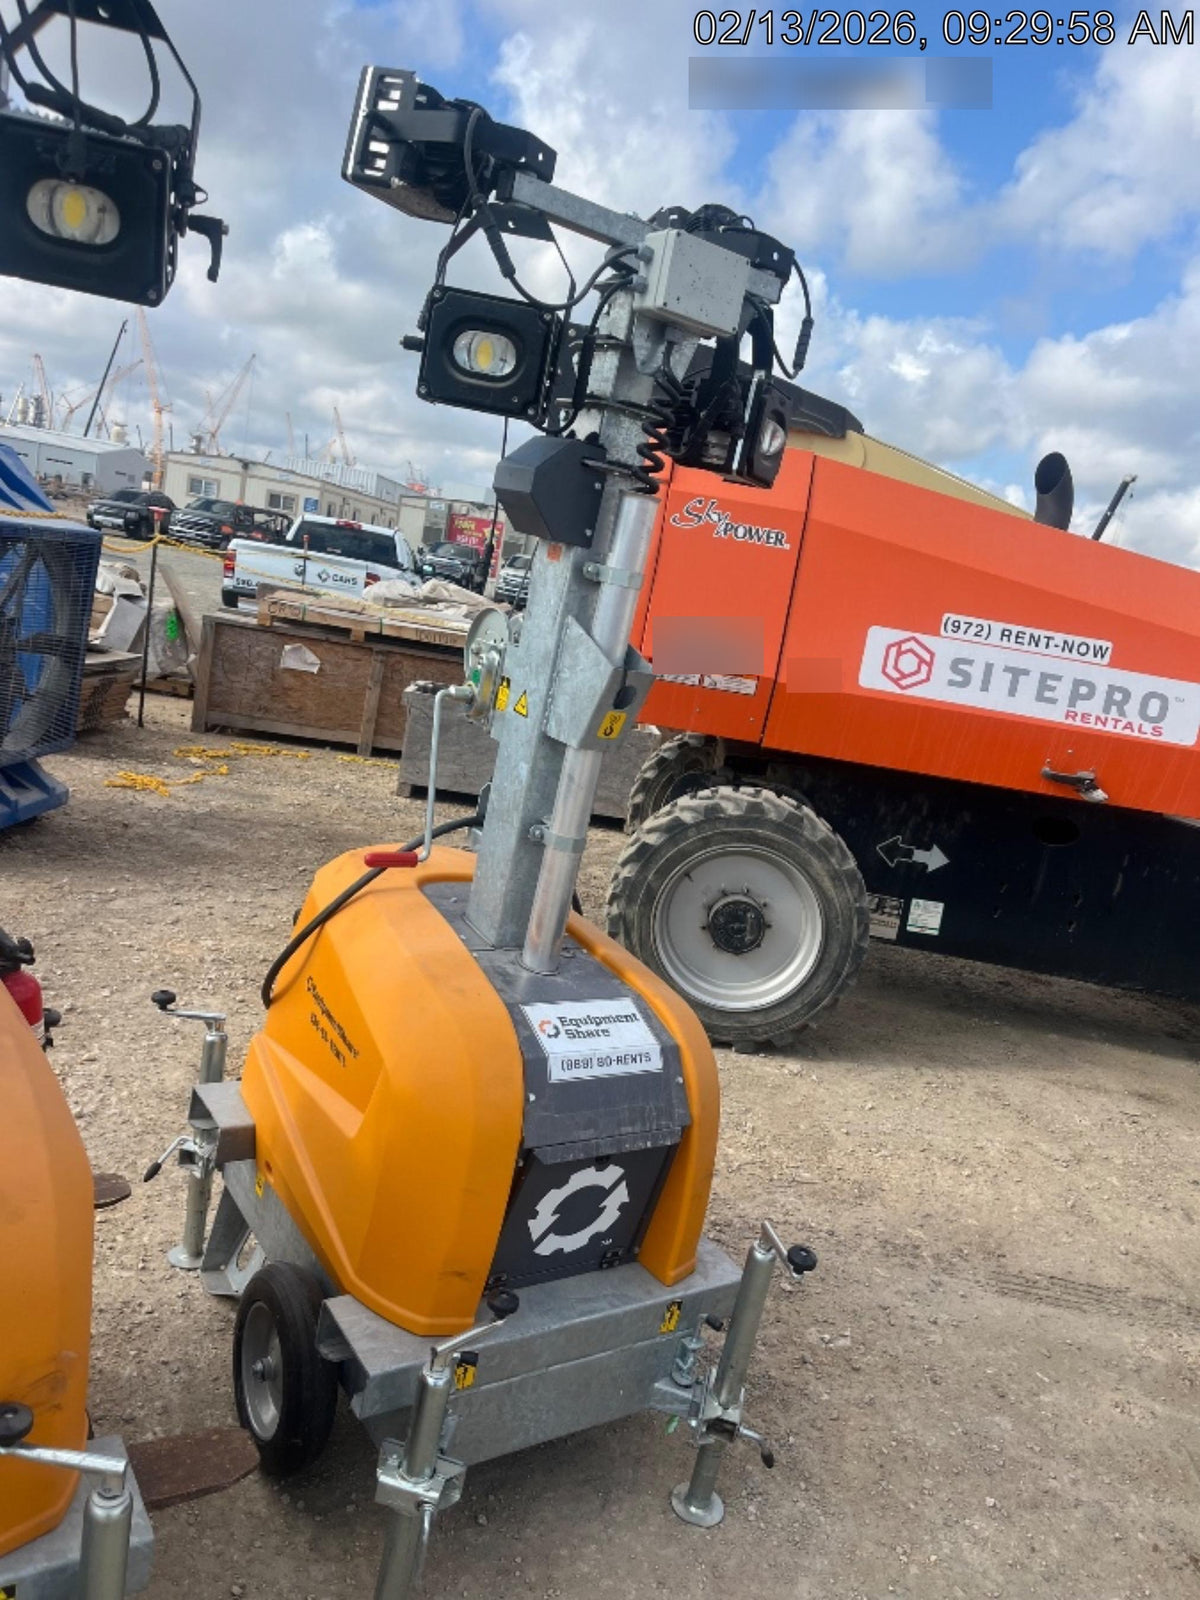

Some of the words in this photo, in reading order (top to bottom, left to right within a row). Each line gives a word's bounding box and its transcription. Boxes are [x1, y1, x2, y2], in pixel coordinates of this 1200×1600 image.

[669, 497, 731, 537] Sky
[722, 520, 786, 547] POWER
[942, 615, 993, 641] (972)
[999, 629, 1111, 661] RENT-NOW
[946, 656, 1170, 725] SITEPRO
[1064, 709, 1165, 738] RENTALS
[556, 1012, 640, 1028] Equipment
[564, 1027, 611, 1040] Share
